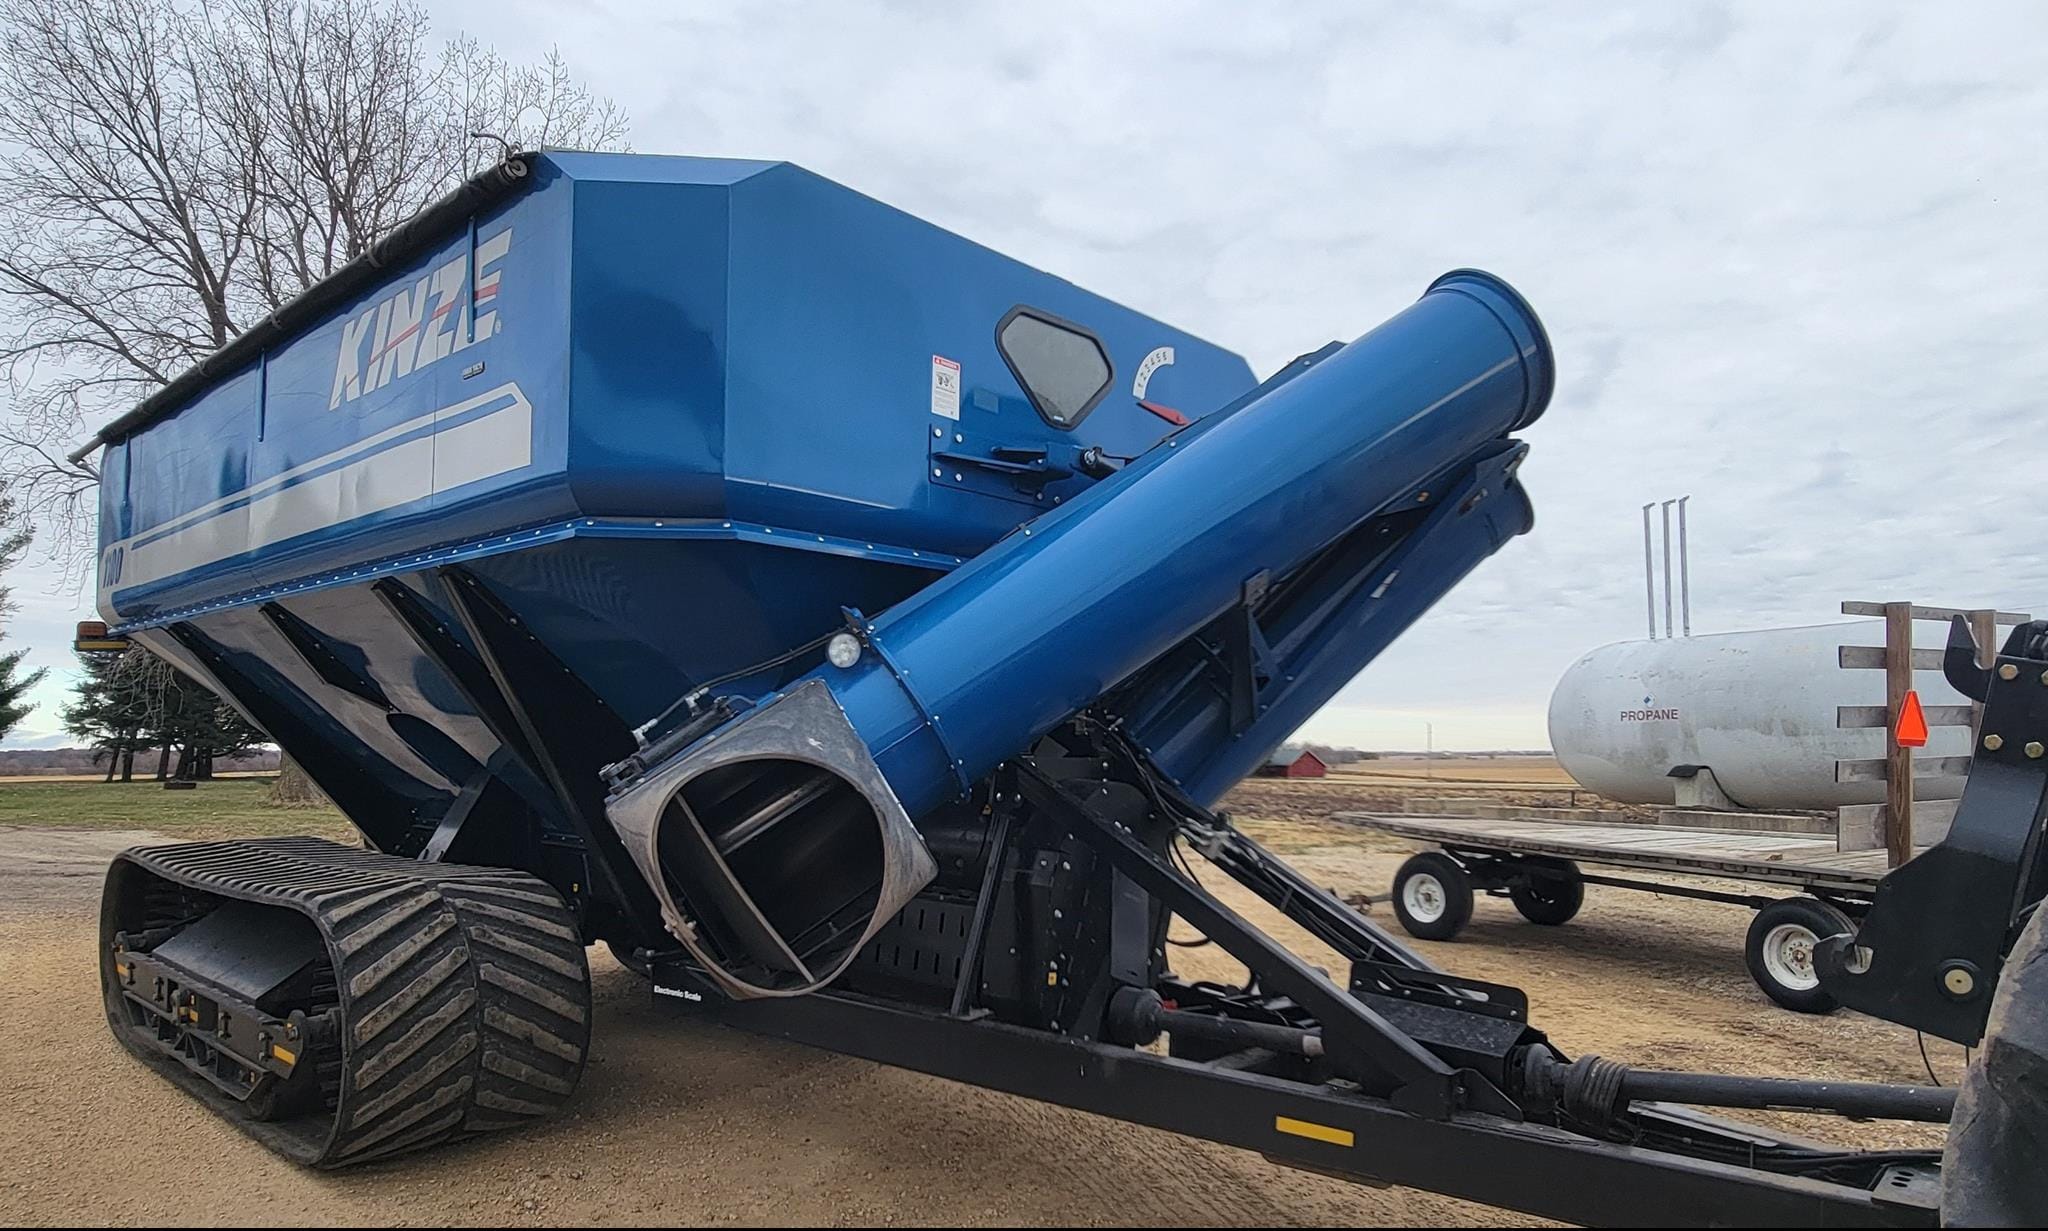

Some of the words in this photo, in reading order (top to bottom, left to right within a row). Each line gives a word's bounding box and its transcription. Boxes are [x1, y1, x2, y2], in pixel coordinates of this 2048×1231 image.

[329, 227, 513, 411] KINZE
[1620, 709, 1679, 721] PROPANE
[654, 985, 683, 997] Electronic
[685, 991, 701, 1001] Scale
